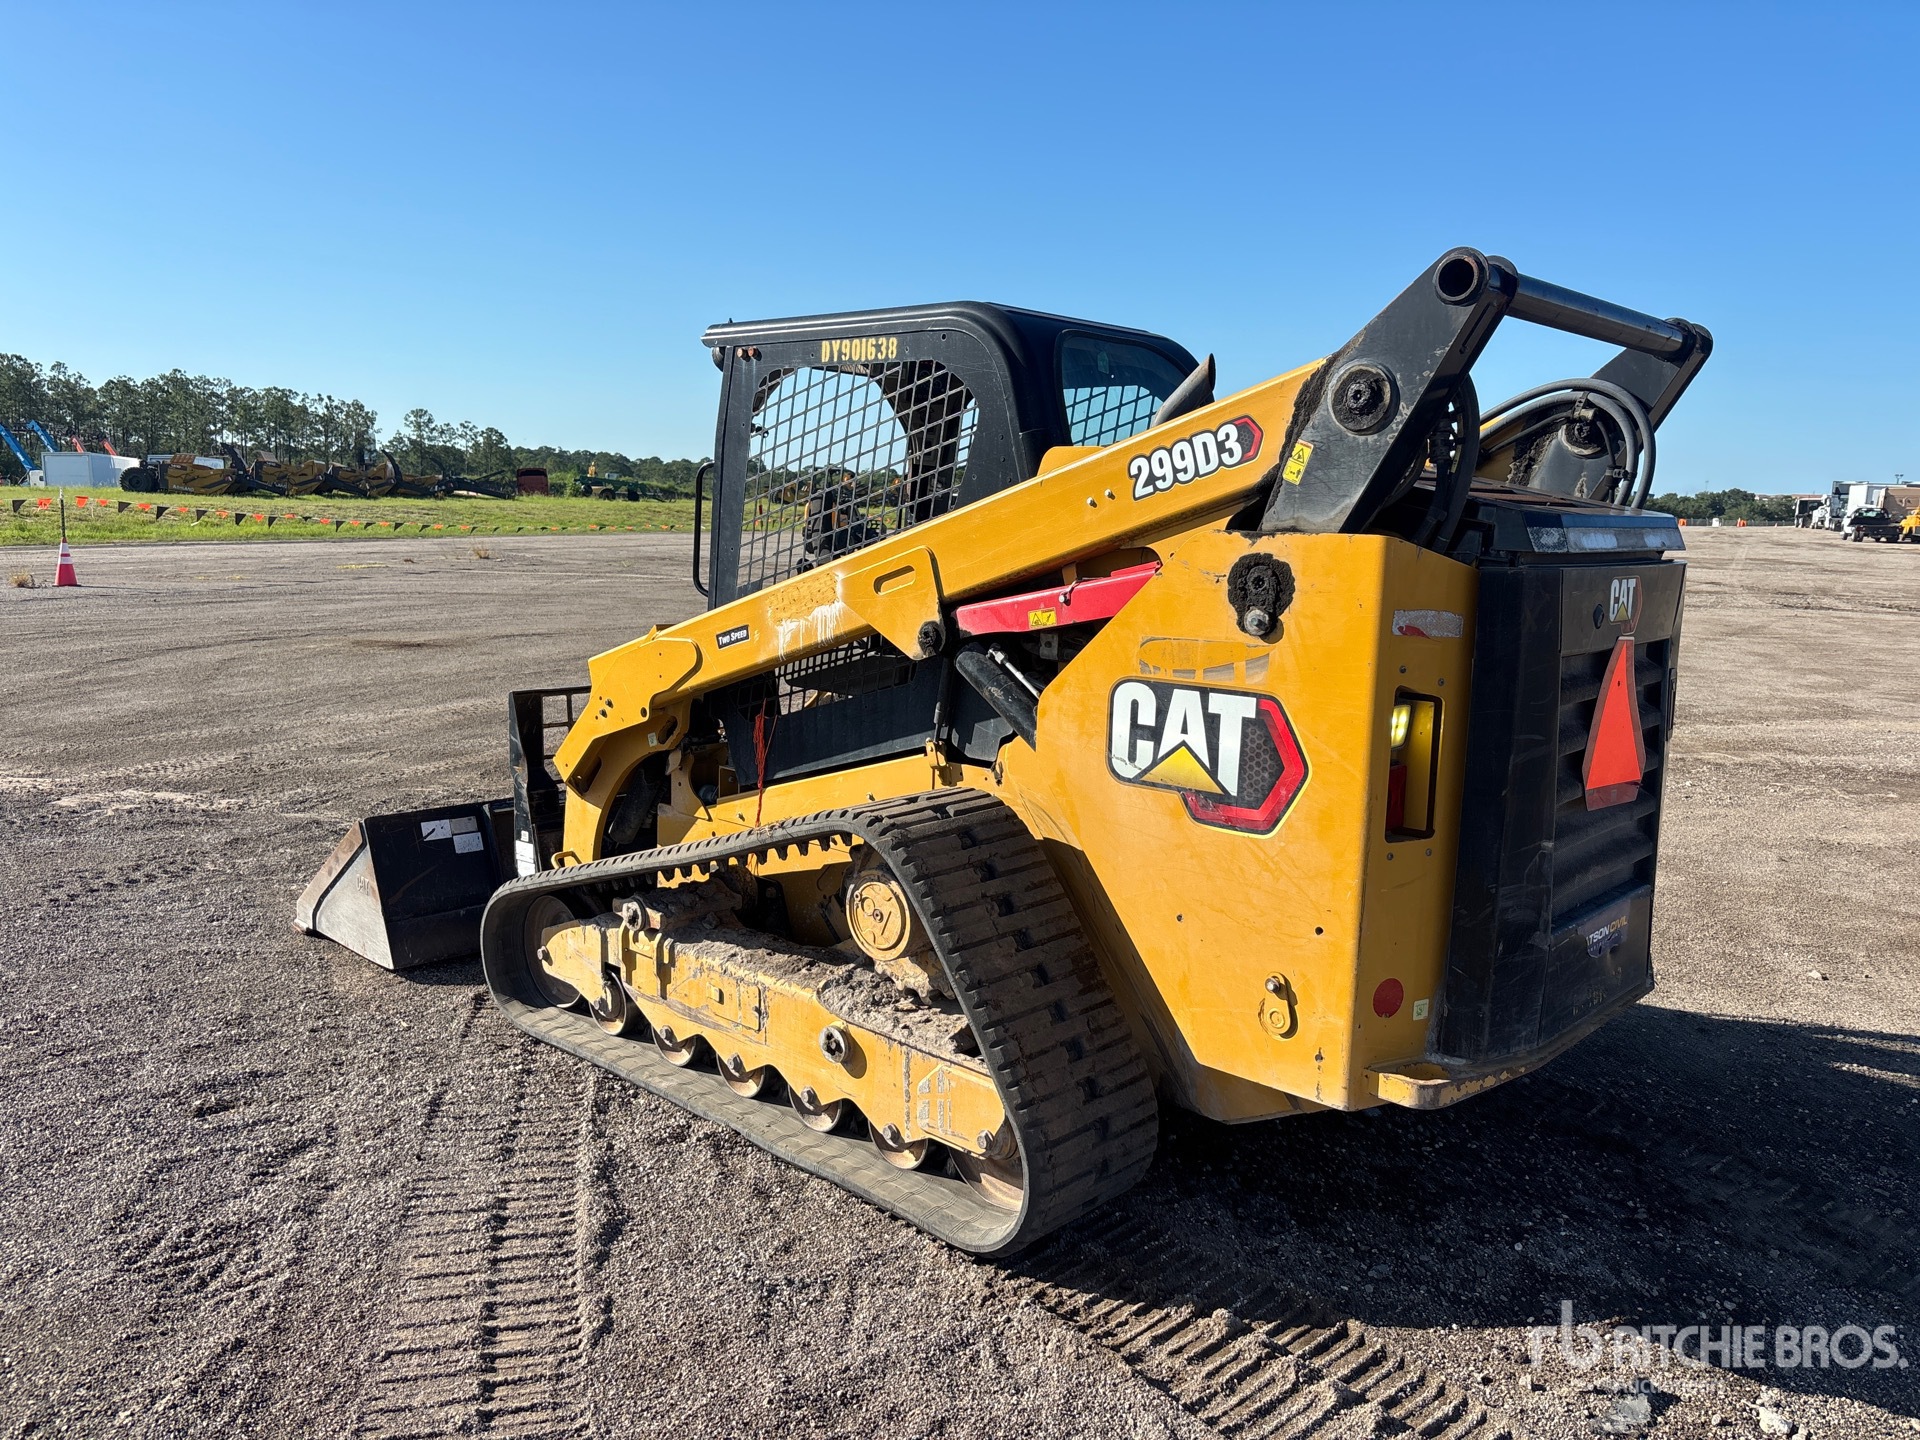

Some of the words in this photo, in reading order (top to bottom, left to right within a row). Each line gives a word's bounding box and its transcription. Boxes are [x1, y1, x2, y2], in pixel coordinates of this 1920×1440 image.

[821, 337, 897, 362] DY901638
[1130, 424, 1242, 498] 299D3
[1609, 578, 1637, 622] CAT
[1111, 681, 1257, 797] CAT
